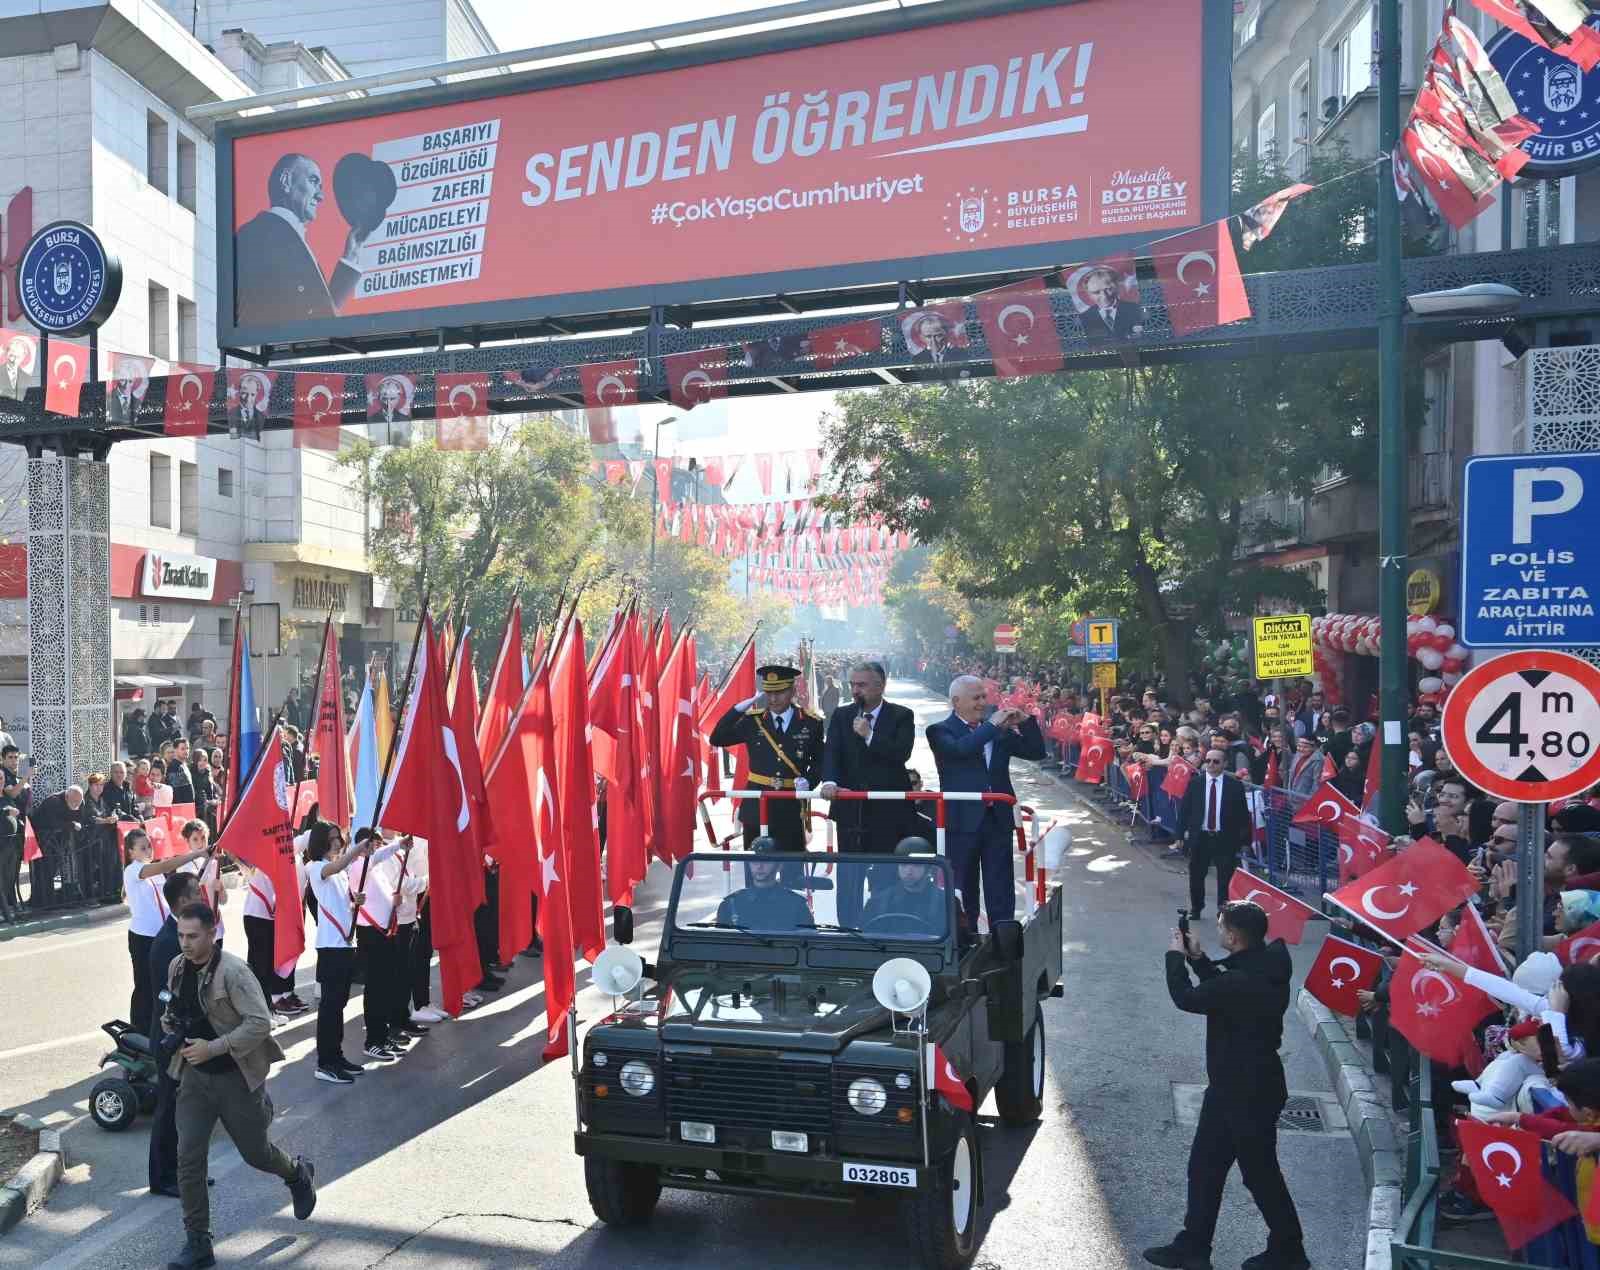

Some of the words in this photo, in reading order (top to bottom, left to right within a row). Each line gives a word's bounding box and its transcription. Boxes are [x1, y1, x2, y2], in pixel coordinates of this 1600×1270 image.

[521, 114, 738, 208] SENDEN
[751, 42, 1094, 165] ÖĞRENDİK!
[422, 122, 493, 154] BAŞARIYI
[400, 146, 488, 182] ÖZGÜRLÜĞÜ
[1111, 166, 1174, 187] Mustafa
[431, 174, 486, 204] ZAFERİ
[1007, 184, 1079, 206] BURSA
[1101, 181, 1187, 205] BOZBEY
[649, 173, 925, 227] #ÇokYaşaCumhuriyet
[1007, 200, 1077, 217] BÜYÜKŞEHİR
[386, 202, 482, 238] MÜCADELEYİ
[1007, 213, 1079, 229] BELEDİYESİ
[46, 231, 81, 248] BURSA
[377, 232, 477, 266] BAĞIMSIZLIĞI
[363, 258, 473, 293] GÜLÜMSETMEYİ
[1512, 467, 1584, 545] P
[1490, 548, 1575, 566] POLİS
[1520, 570, 1547, 583] VE
[1483, 586, 1590, 601] ZABITA
[1477, 603, 1595, 620] ARAÇLARINA
[1094, 625, 1108, 642] T
[1265, 622, 1299, 633] DİKKAT
[1504, 621, 1566, 637] AİTTİR
[1542, 691, 1574, 713] m
[848, 1167, 910, 1185] 032805
